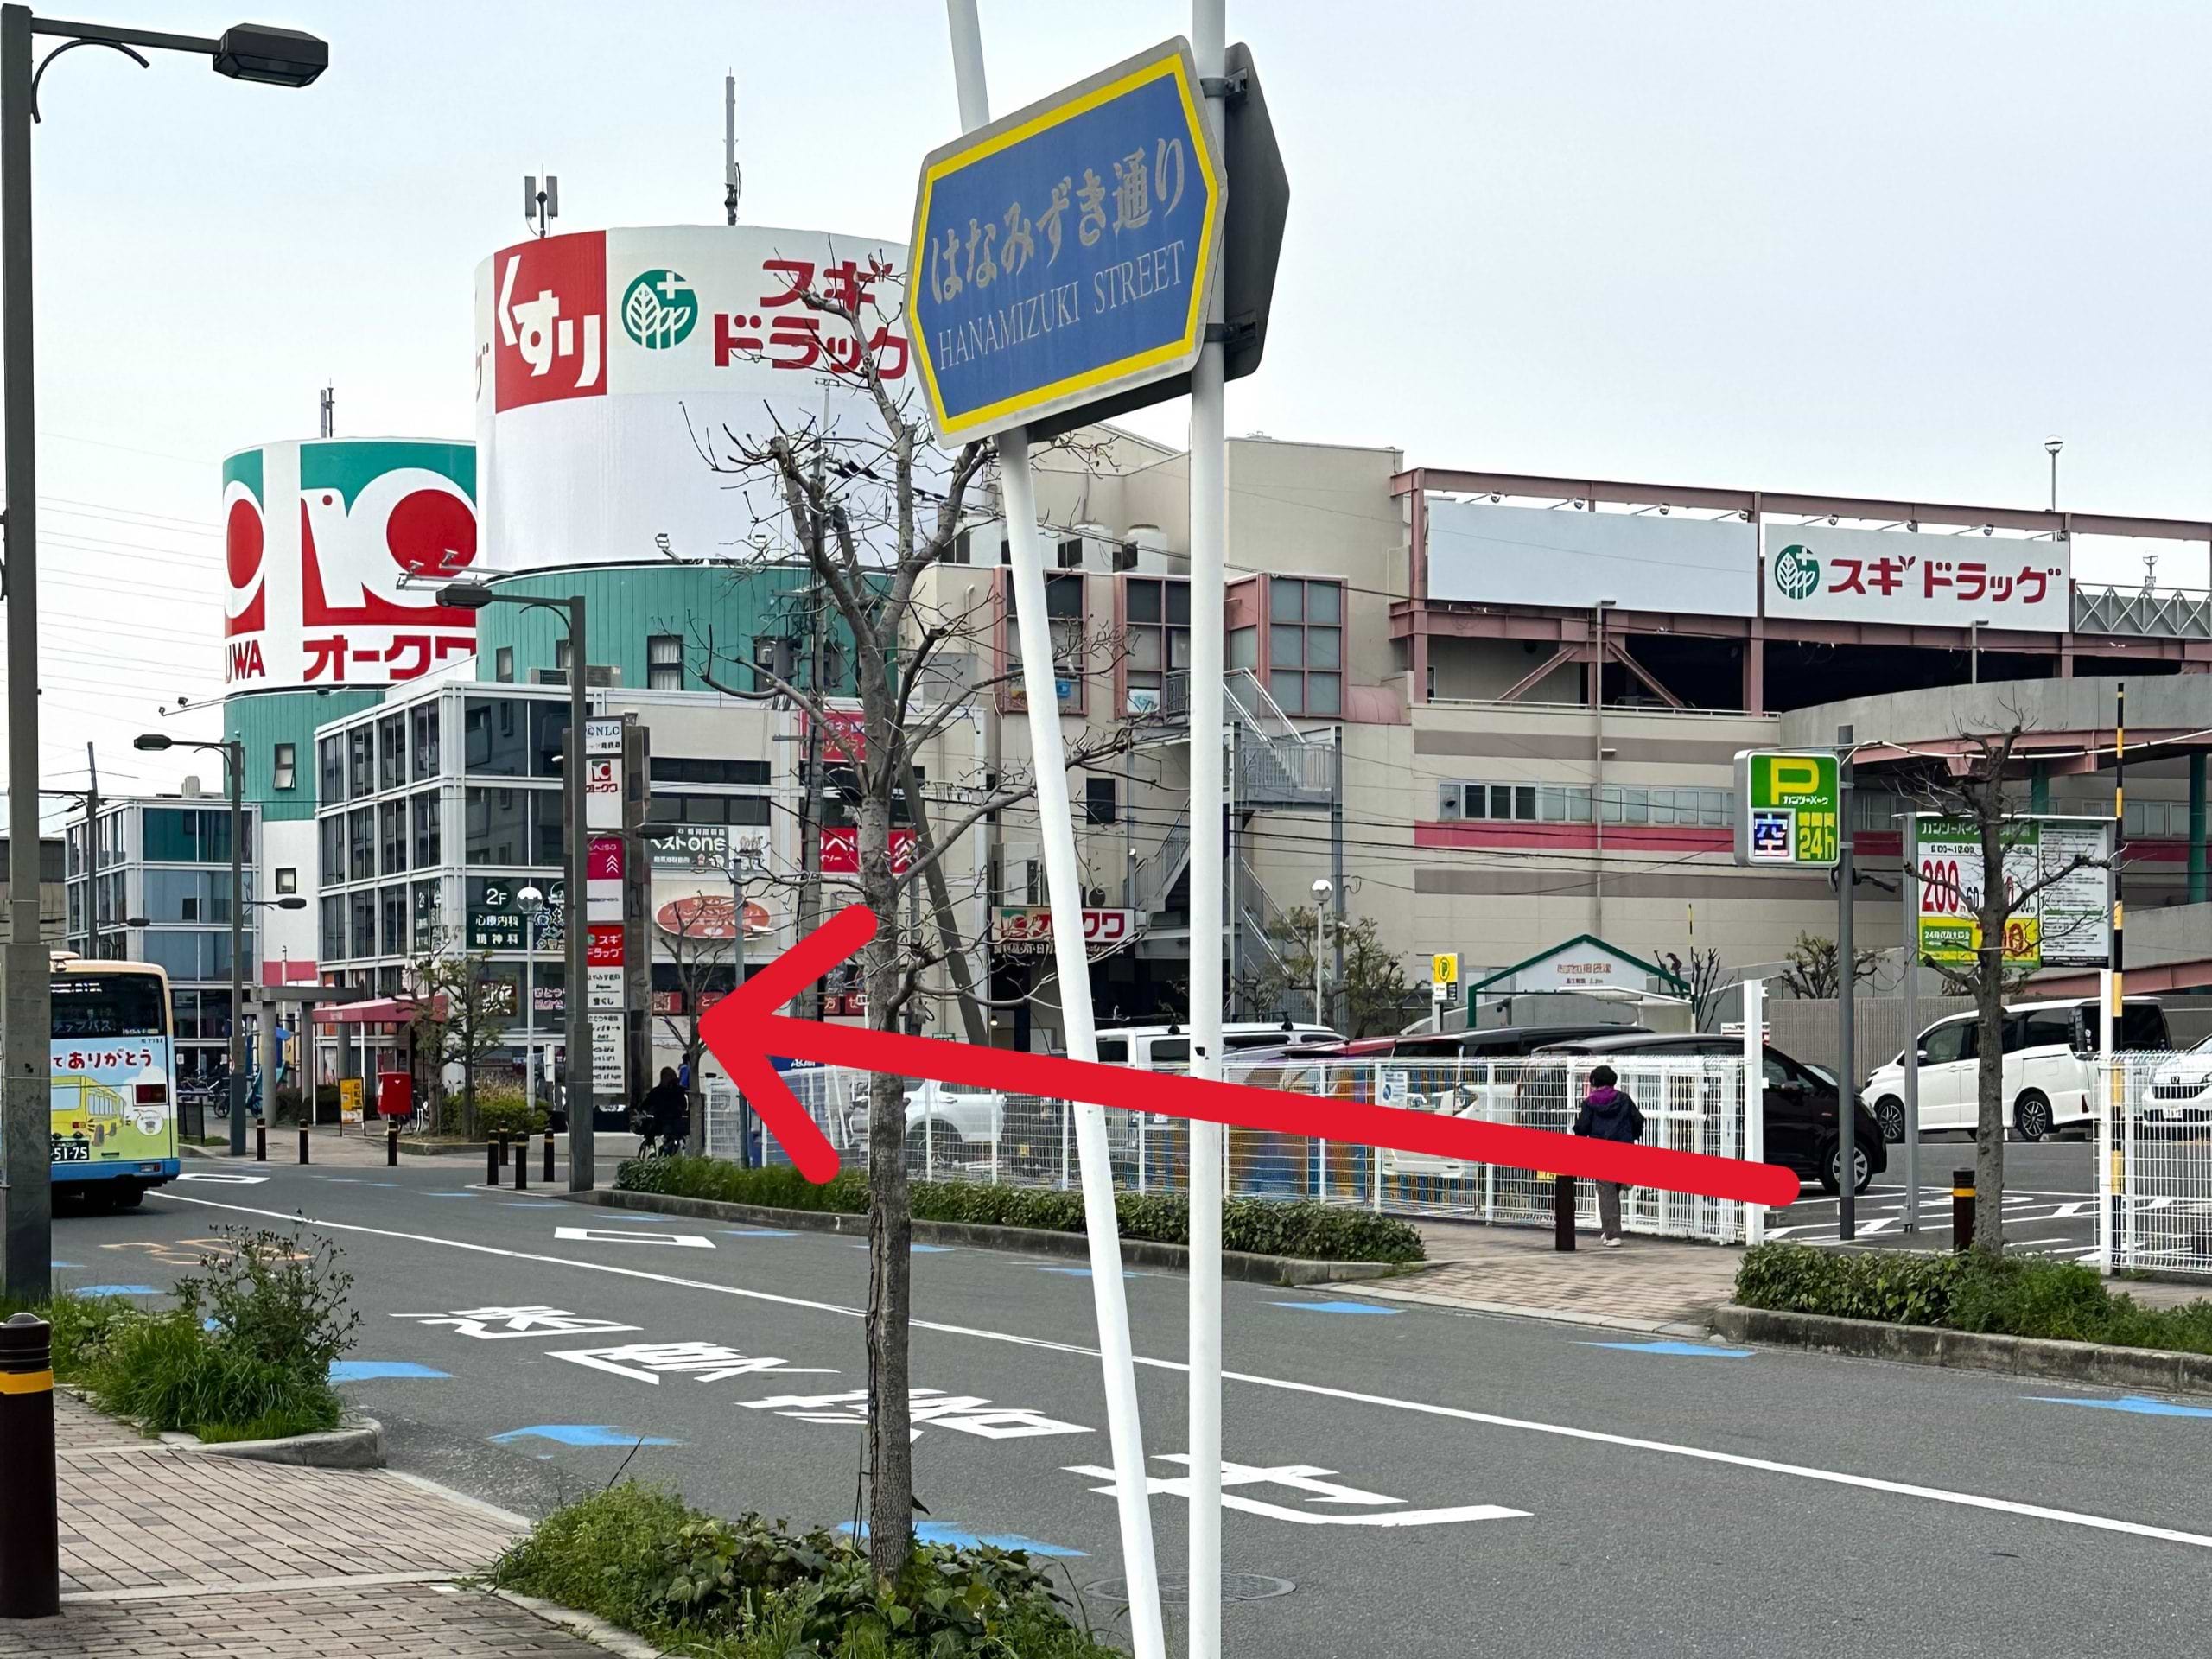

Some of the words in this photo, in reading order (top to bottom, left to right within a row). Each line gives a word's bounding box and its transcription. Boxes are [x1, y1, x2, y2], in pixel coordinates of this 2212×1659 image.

[931, 137, 1185, 304] はなみずき通り
[497, 254, 601, 388] くすり
[939, 282, 1079, 371] HANAMIZUKI
[1094, 240, 1185, 313] STREET
[1770, 757, 1820, 805] P
[1754, 812, 1789, 856] 空
[1799, 826, 1835, 860] 24h
[486, 888, 508, 905] 2F
[1922, 860, 1960, 913] 200
[475, 915, 519, 927] 心療内科
[476, 933, 519, 944] 精神科
[599, 934, 622, 944] スギ
[54, 1147, 88, 1160] 51-75
